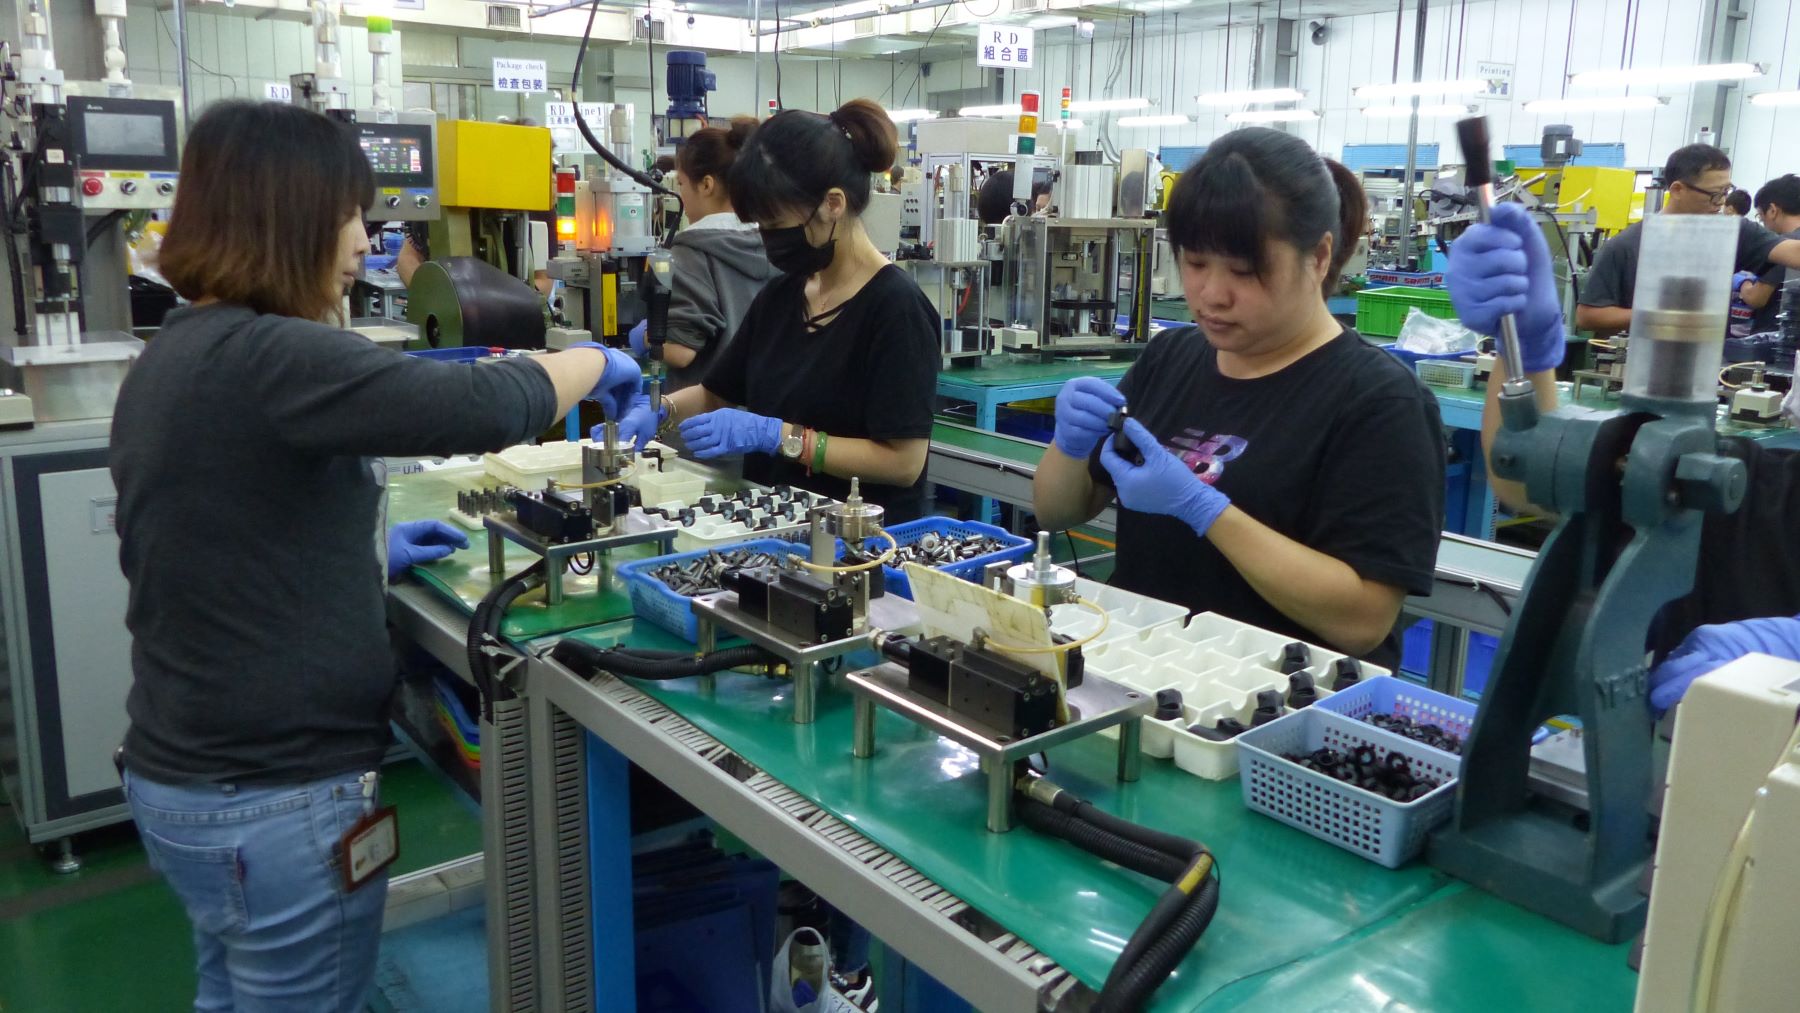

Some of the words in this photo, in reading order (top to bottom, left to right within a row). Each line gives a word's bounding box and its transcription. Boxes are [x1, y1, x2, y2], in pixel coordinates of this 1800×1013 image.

[984, 45, 1028, 62] 組合區
[496, 61, 523, 71] Package
[525, 63, 544, 71] check
[1480, 65, 1510, 77] Printing
